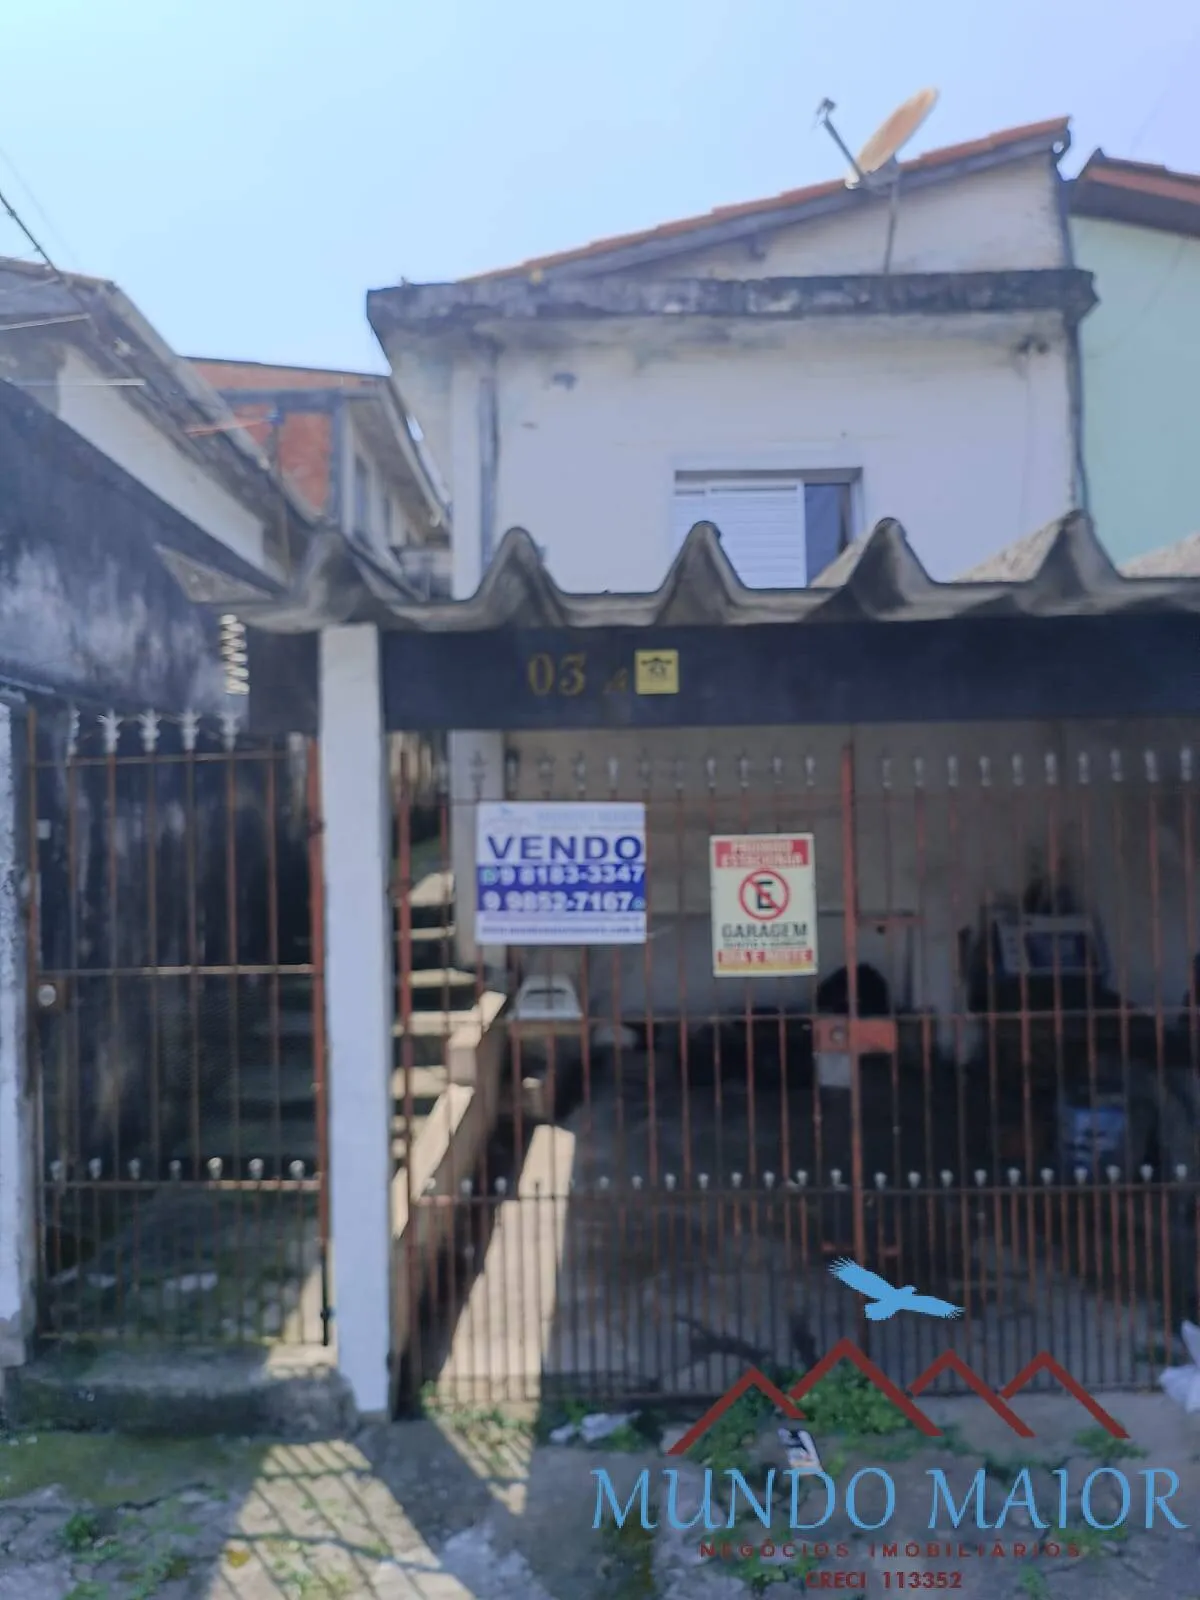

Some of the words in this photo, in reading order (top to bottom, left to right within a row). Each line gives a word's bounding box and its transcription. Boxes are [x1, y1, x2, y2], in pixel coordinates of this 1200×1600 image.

[528, 653, 587, 696] 03
[487, 836, 642, 860] VENDO
[722, 922, 808, 939] GARAGEM
